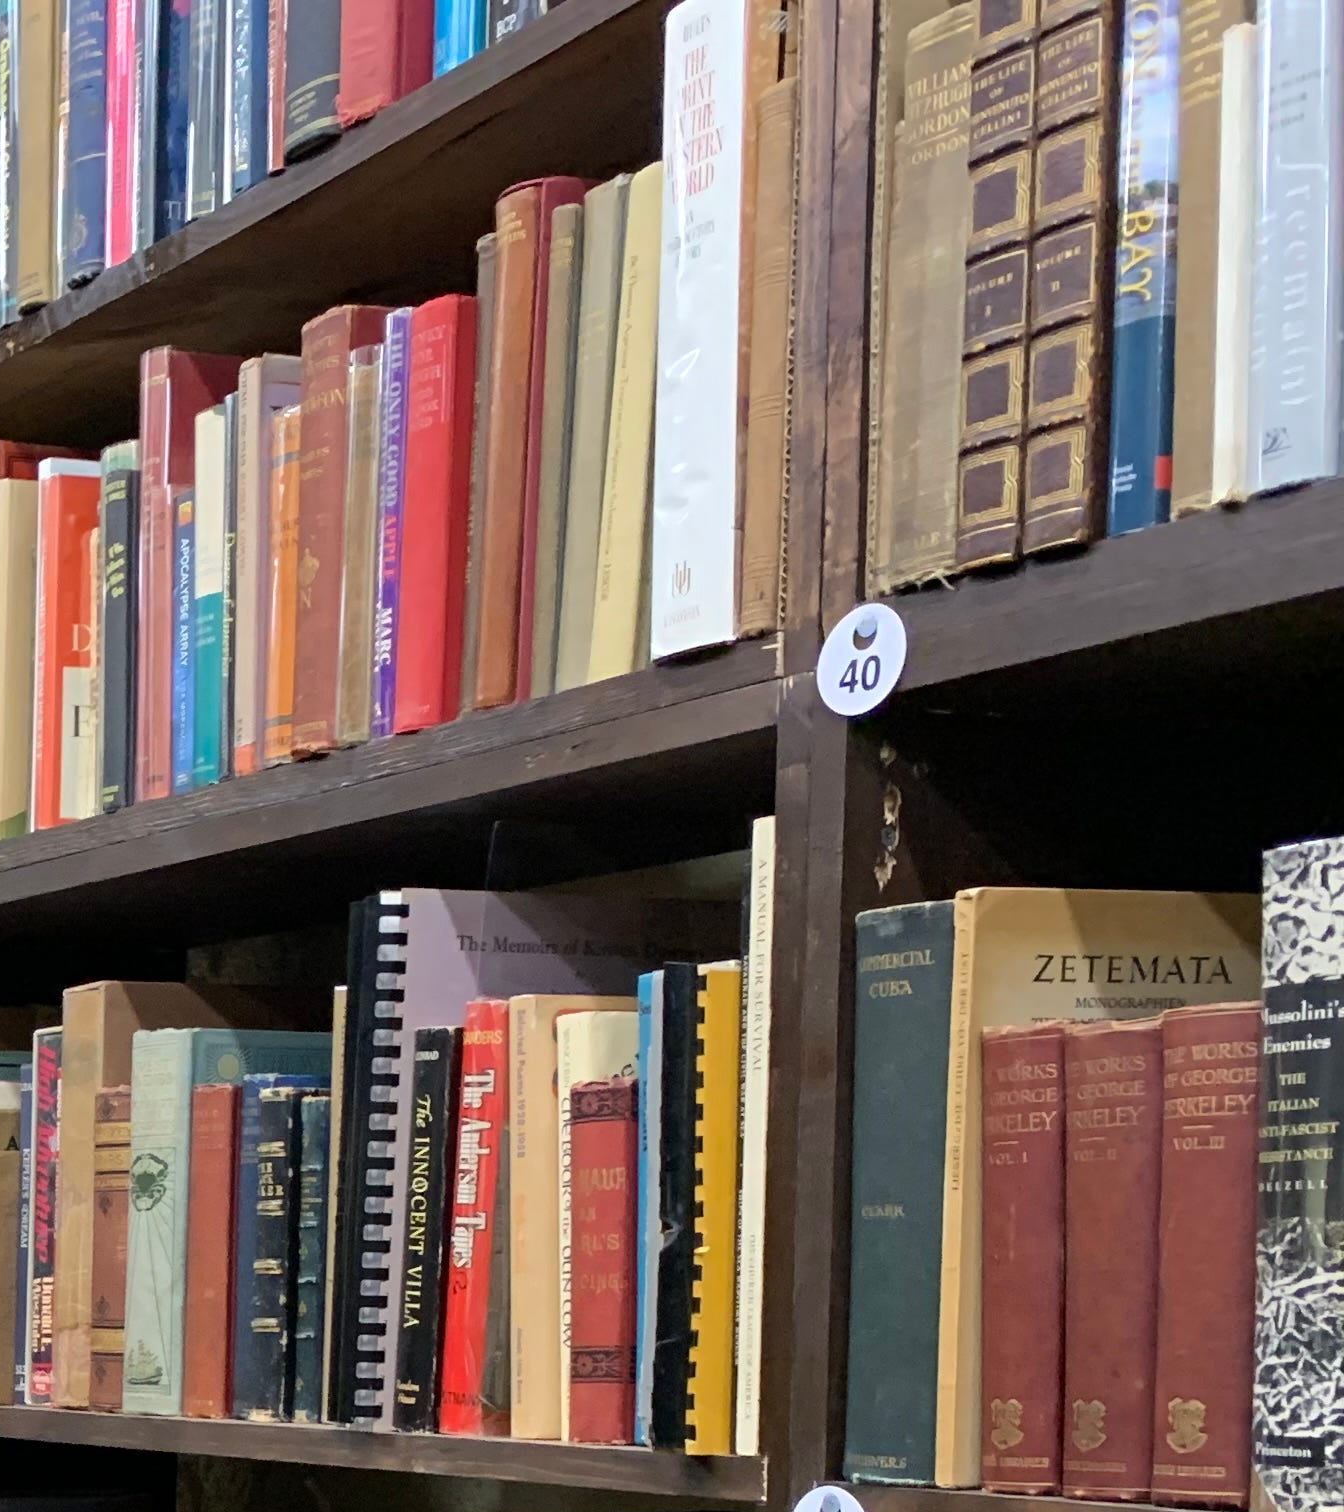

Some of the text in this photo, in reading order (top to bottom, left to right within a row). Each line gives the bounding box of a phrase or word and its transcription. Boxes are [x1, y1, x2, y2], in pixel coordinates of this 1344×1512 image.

[1118, 206, 1156, 303] BAY
[382, 443, 400, 508] GOOD
[178, 538, 190, 621] APOCALYPSE
[178, 624, 190, 668] ARRAY
[376, 606, 393, 669] MARC
[839, 655, 881, 693] 40
[755, 875, 769, 944] MANUAL
[457, 934, 487, 953] The
[754, 953, 767, 986] FOR
[868, 980, 914, 999] CUBA
[1031, 953, 1233, 986] ZETEMATA
[516, 1007, 526, 1095] Selected Poems
[751, 990, 766, 1073] SURVIVAL
[1192, 1042, 1258, 1062] WORKS
[1263, 1035, 1332, 1056] Enemies
[1182, 1069, 1257, 1088] GEORGE
[1279, 1073, 1306, 1087] THE
[21, 1148, 32, 1200] KEPLER'S
[450, 1067, 496, 1270] The Anderson Tapes
[560, 1143, 573, 1198] BOOK
[401, 1093, 431, 1329] The INNOCENT VILLA
[561, 1243, 573, 1294] DUN
[560, 1296, 573, 1349] COW
[1254, 1441, 1313, 1459] Princeton
